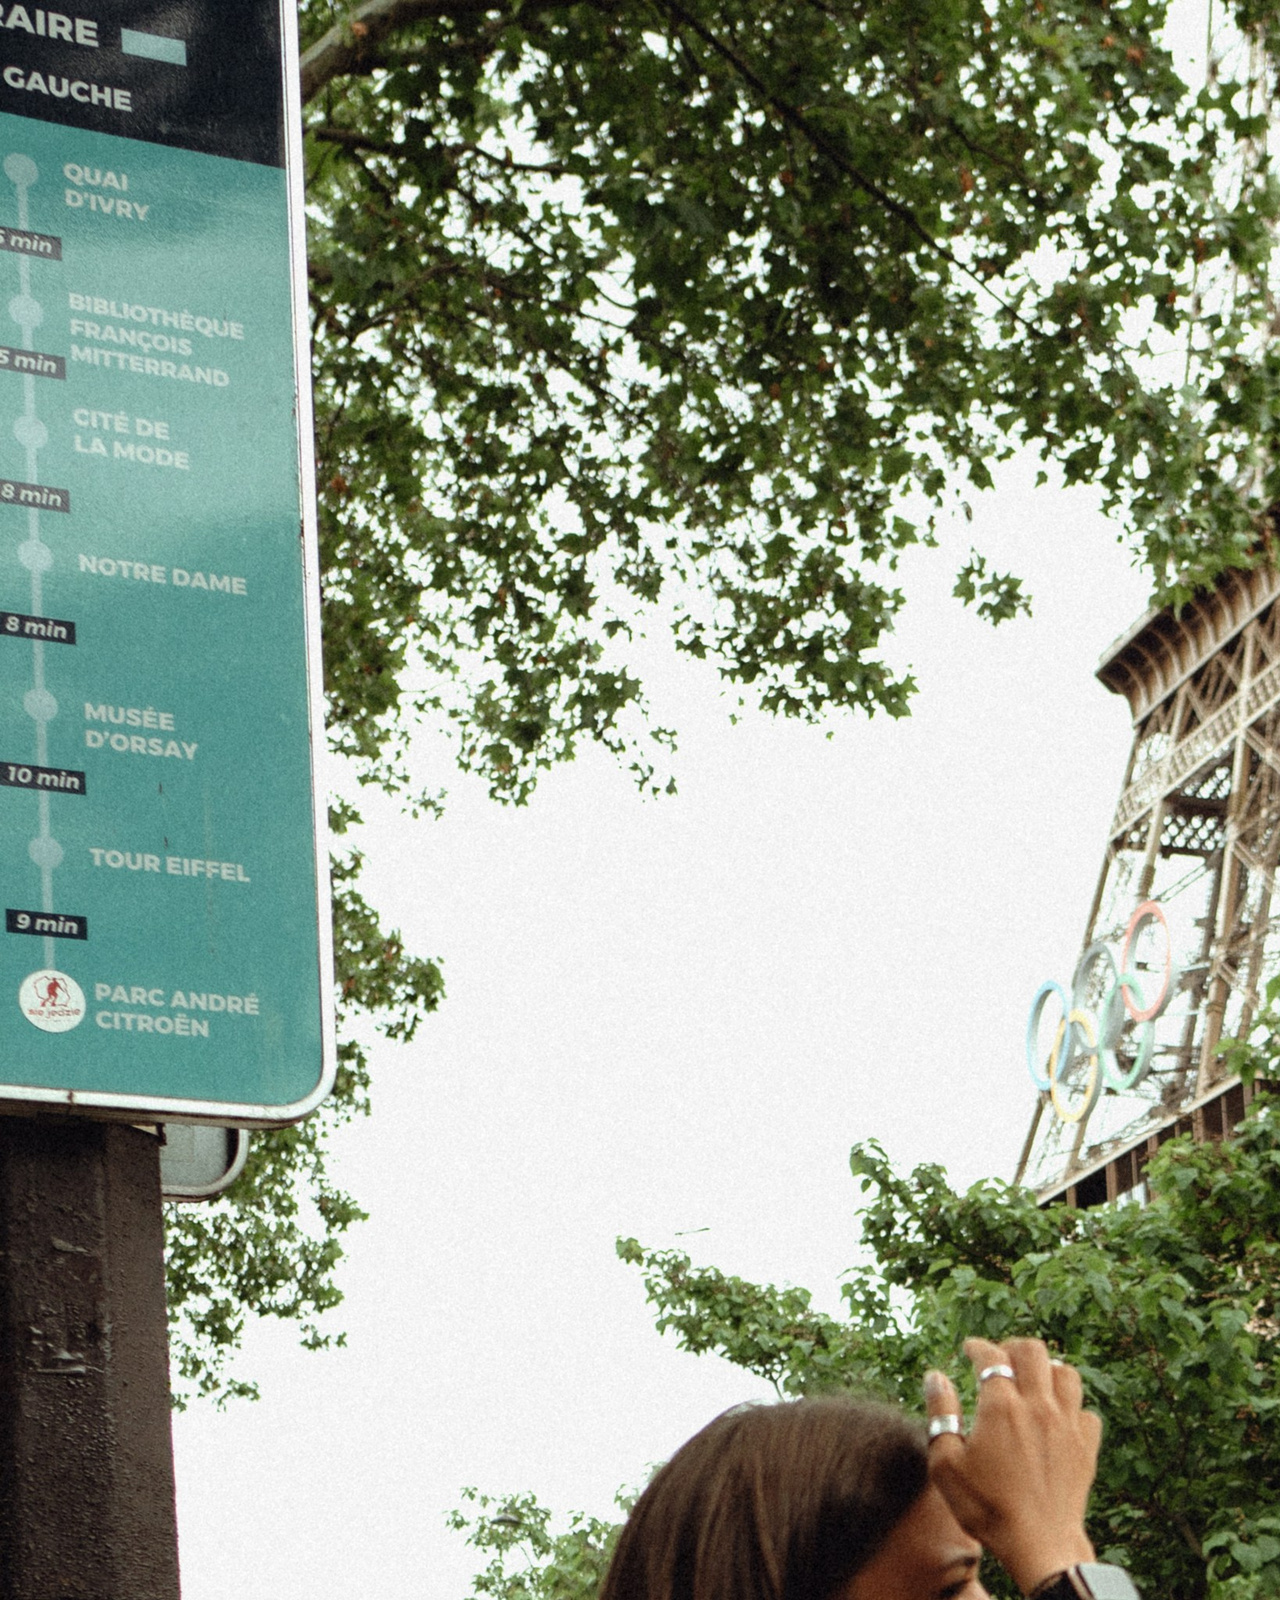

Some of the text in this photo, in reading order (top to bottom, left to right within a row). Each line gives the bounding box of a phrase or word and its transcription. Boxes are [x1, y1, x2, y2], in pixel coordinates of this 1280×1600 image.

[0, 4, 99, 47] AIRE
[3, 66, 132, 112] GAUCHE
[63, 163, 128, 191] QUAI
[65, 188, 150, 221] D'IVRY
[10, 234, 52, 254] min
[69, 318, 193, 356] FRANÇOIS
[14, 354, 57, 374] min
[70, 343, 230, 387] MITTERRAND
[73, 408, 170, 441] CITÉ DE
[74, 434, 190, 471] LA MODE
[1, 483, 62, 507] 8 min
[78, 553, 248, 596] NOTRE DAME
[5, 616, 67, 640] 8 min
[84, 702, 175, 731] MUSÉE
[85, 724, 199, 761] D'ORSAY
[8, 765, 80, 790] 10 min
[89, 847, 251, 883] TOUR EIFFEL
[16, 914, 79, 935] 9 min
[95, 982, 260, 1017] PARC ANDRÉ
[95, 1010, 210, 1038] CITROËN
